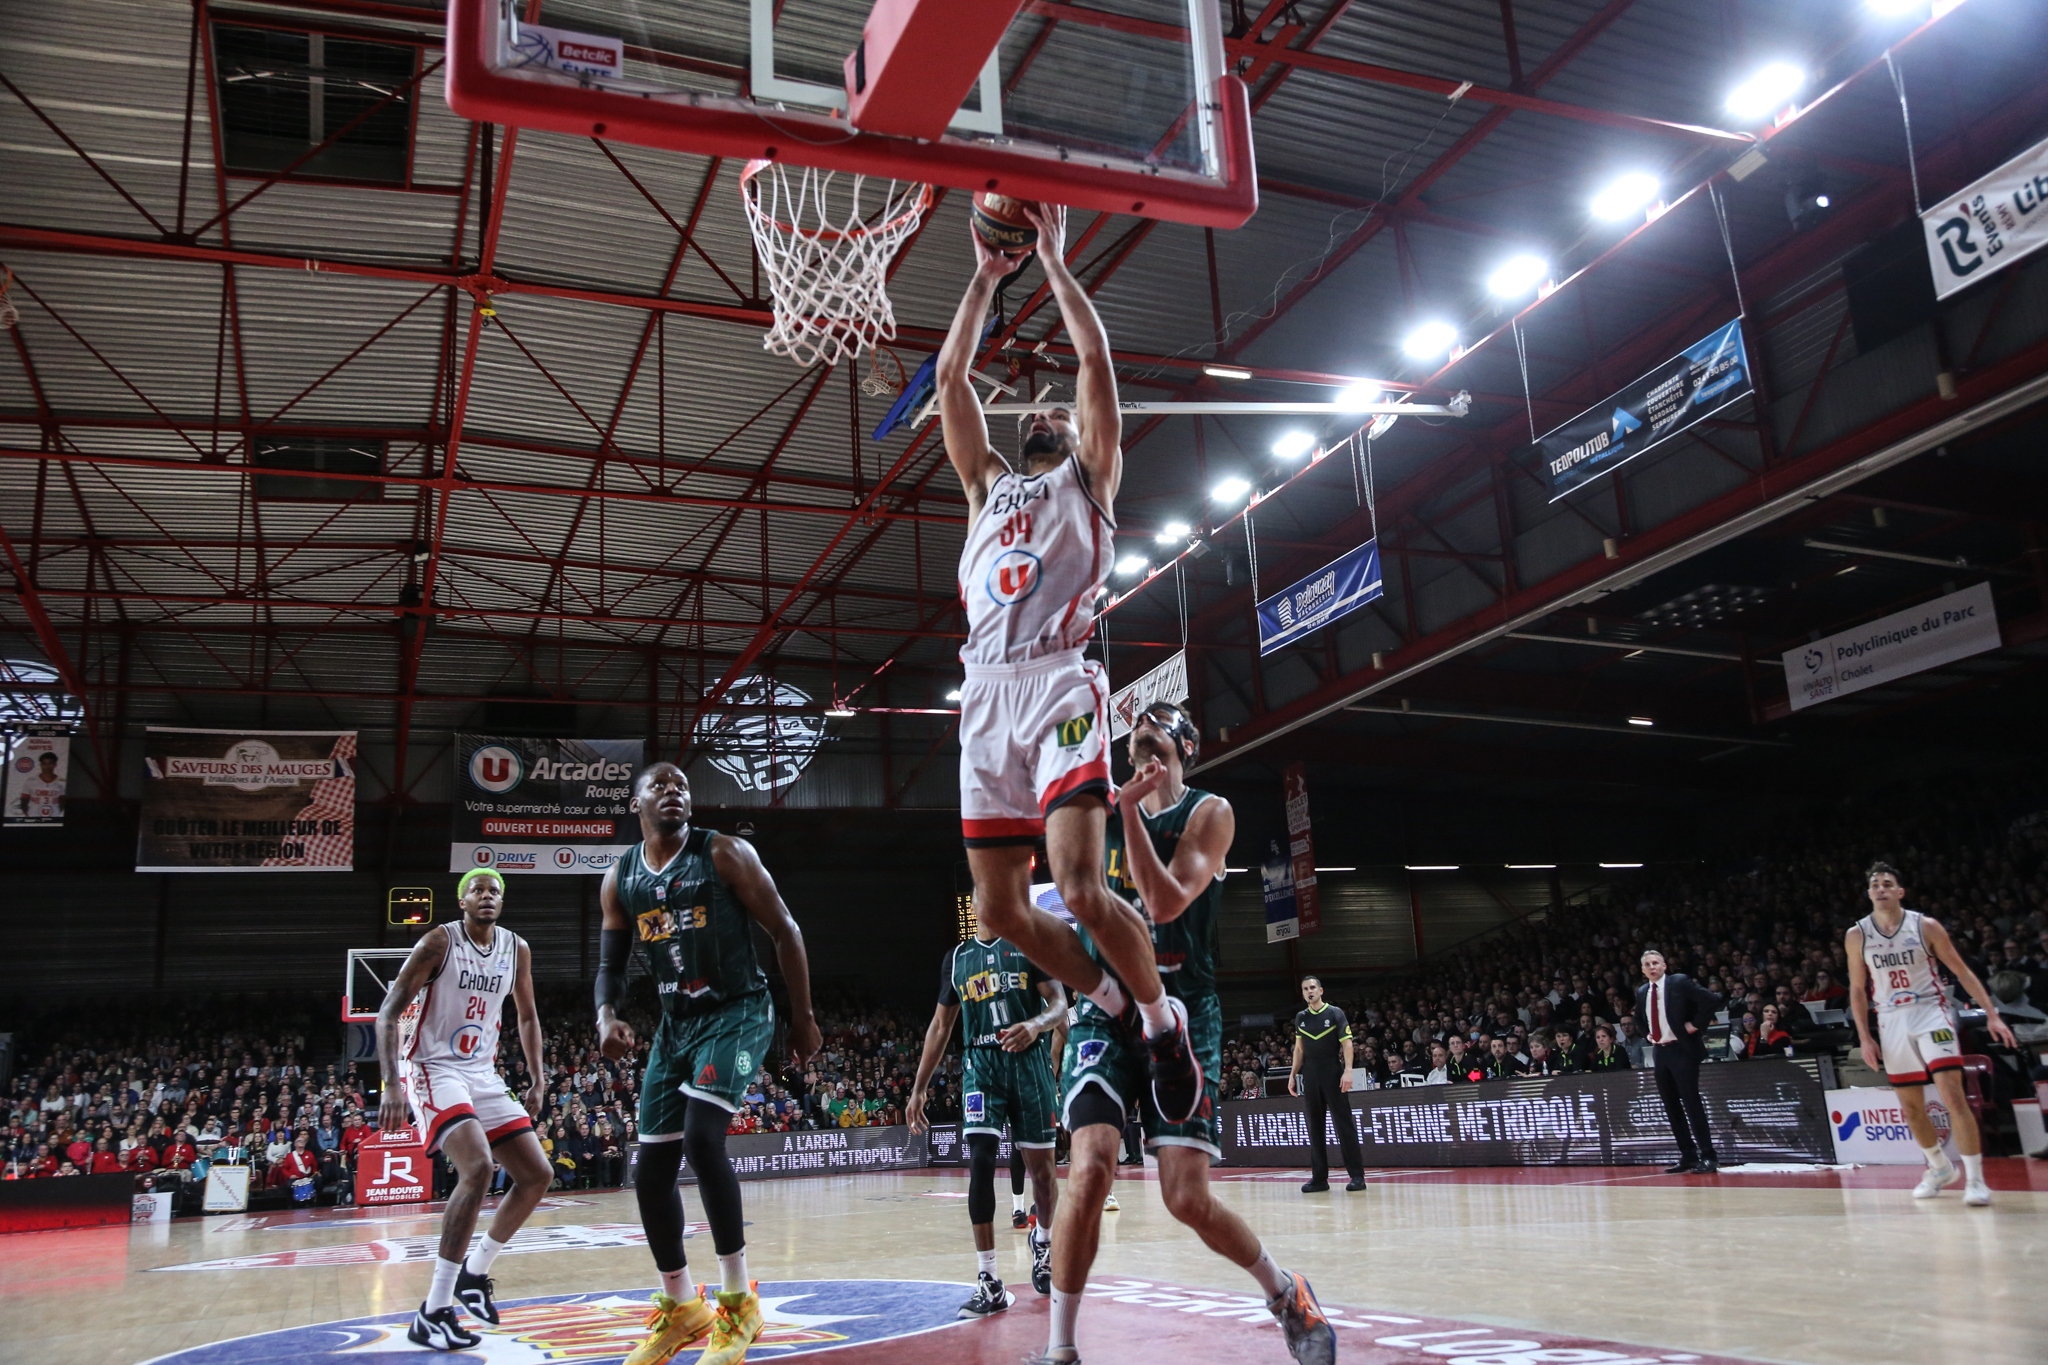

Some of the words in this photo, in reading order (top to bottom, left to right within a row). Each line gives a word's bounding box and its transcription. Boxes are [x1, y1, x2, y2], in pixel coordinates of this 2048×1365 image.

[562, 45, 612, 63] Betclic
[1971, 195, 2005, 258] Events
[1646, 374, 1680, 399] CHARPENTE
[1647, 380, 1684, 407] COUVERTURE
[1650, 403, 1677, 423] BARDAGE
[1550, 431, 1610, 476] TEOPOLITUB
[1000, 510, 1032, 547] 34
[1000, 563, 1030, 595] U
[1837, 624, 1918, 661] Polyclinique
[1921, 616, 1940, 633] du
[1943, 605, 1976, 625] Parc
[1840, 663, 1874, 683] Cholet
[171, 760, 238, 775] SAVEURS
[242, 764, 263, 774] DES
[266, 762, 332, 776] MAUGES
[529, 756, 633, 782] Arcades
[208, 775, 249, 784] traditions
[251, 776, 261, 784] de
[263, 775, 295, 786] l'Anjou
[585, 784, 630, 801] Rougé
[1286, 793, 1308, 812] CHOLET
[465, 800, 493, 812] Votre
[496, 802, 561, 815] supermarché
[563, 806, 591, 815] cœur
[594, 804, 607, 815] de
[609, 804, 626, 815] ville
[223, 820, 239, 836] LE
[242, 820, 318, 836] MEILLEUR
[321, 820, 341, 836] DE
[485, 822, 533, 834] OUVERT
[536, 824, 550, 834] LE
[552, 824, 612, 835] DIMANCHE
[189, 842, 230, 859] VOTRE
[497, 852, 537, 863] DRIVE
[1872, 949, 1915, 969] CHOLET
[458, 970, 503, 994] CHOLET
[1888, 969, 1910, 989] 26
[465, 996, 486, 1021] 24
[989, 999, 1010, 1027] 11
[459, 1034, 479, 1053] U
[1237, 1115, 1248, 1147] A
[1248, 1111, 1310, 1147] L'ARENA
[1456, 1094, 1600, 1142] METROPOLE
[383, 1132, 410, 1141] Betclic
[783, 1136, 792, 1152] A
[798, 1131, 848, 1151] L'ARENA
[931, 1131, 957, 1145] LEADERS
[1865, 1125, 1914, 1141] SPORT
[828, 1146, 904, 1167] METROPOLE
[937, 1144, 950, 1156] CUP
[366, 1188, 388, 1197] JEAN
[389, 1185, 424, 1196] ROUYER
[369, 1193, 421, 1202] AUTOMOBILES
